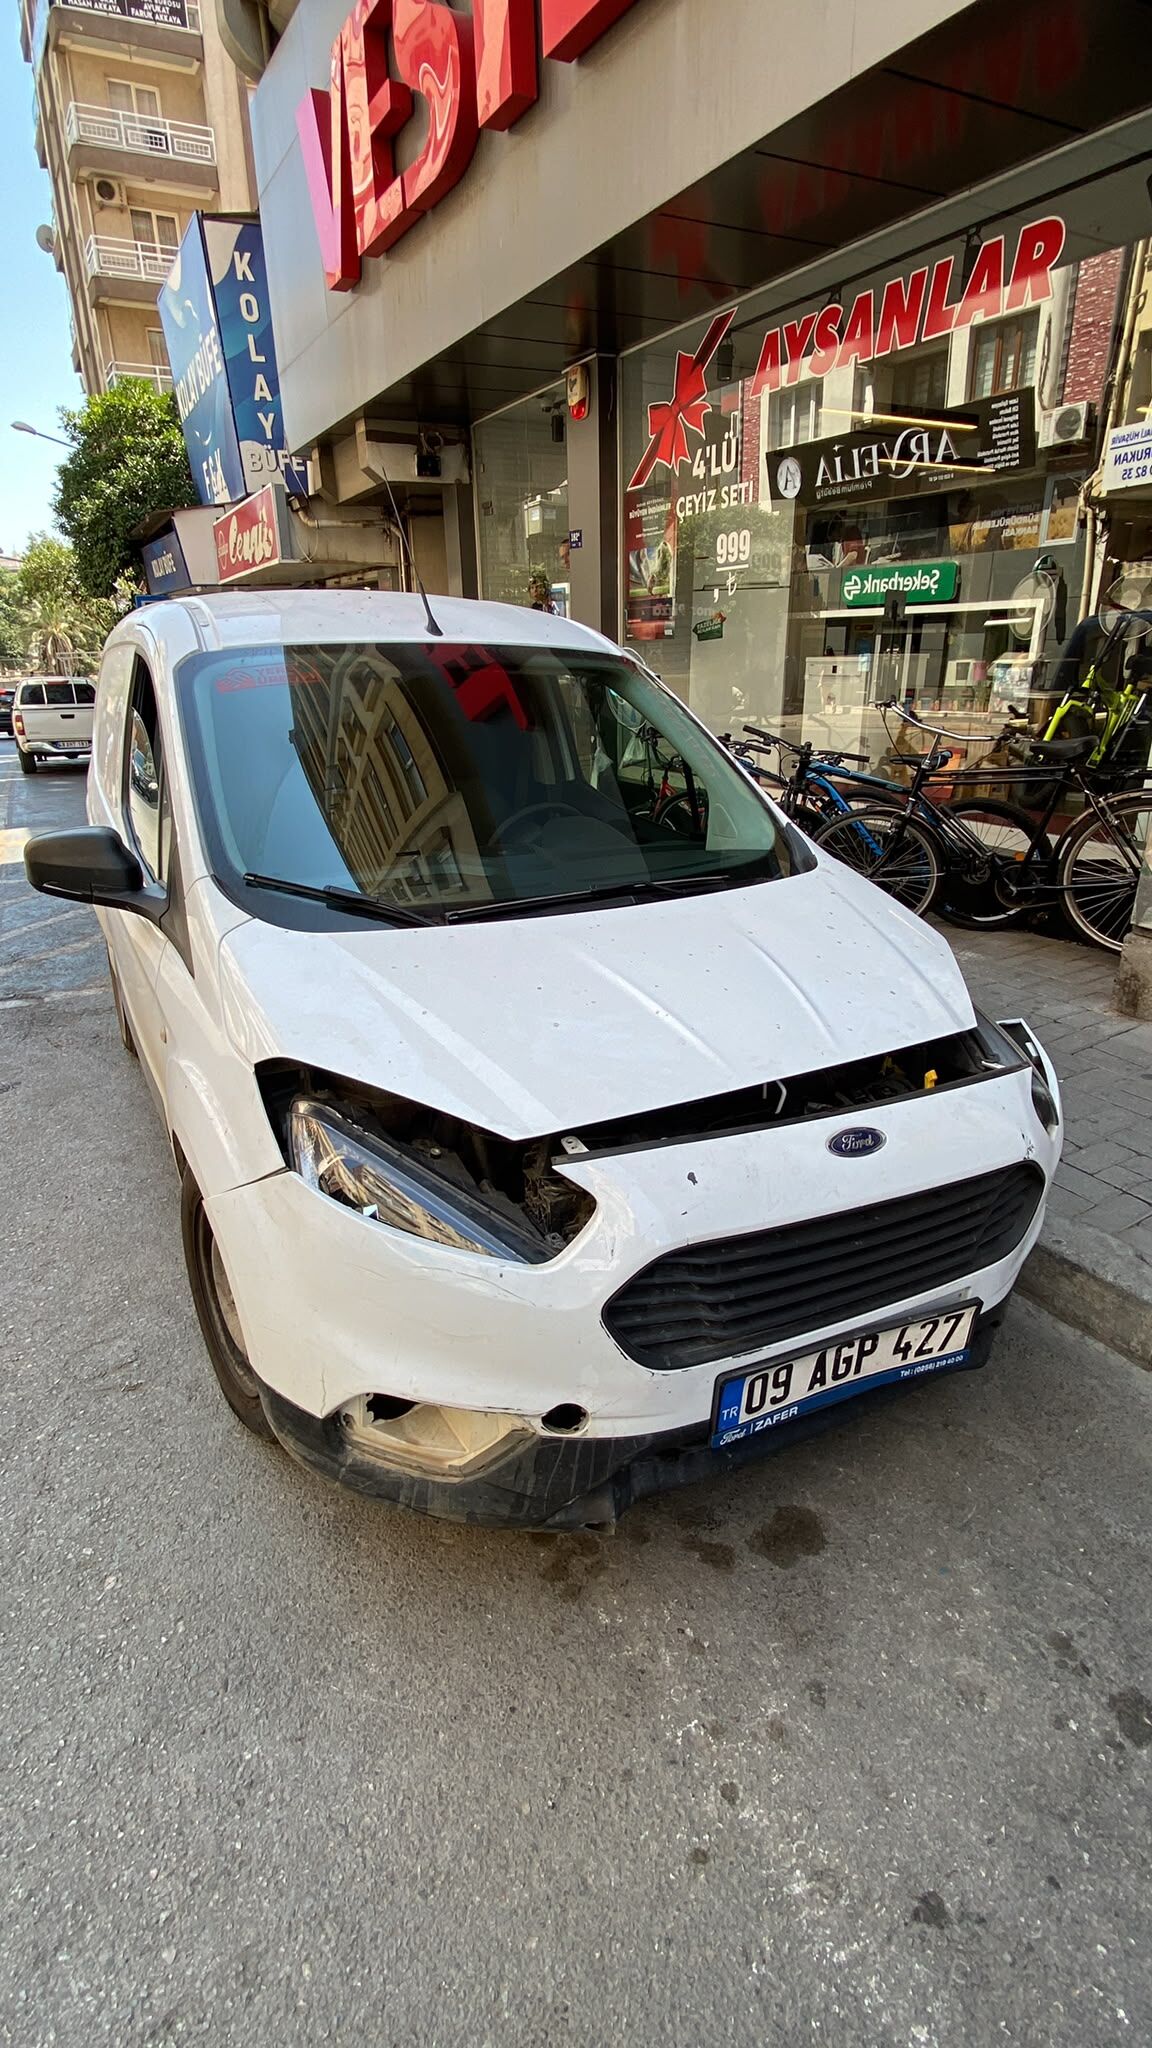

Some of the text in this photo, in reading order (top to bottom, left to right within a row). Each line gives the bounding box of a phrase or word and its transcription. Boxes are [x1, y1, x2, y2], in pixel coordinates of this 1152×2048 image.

[143, 3, 170, 15] AVUKAT
[749, 215, 1067, 399] AYSANLAR
[250, 443, 306, 475] BÜFE
[692, 431, 737, 480] 4'LÜ
[676, 474, 754, 522] ÇEYİZ SETİ
[716, 528, 751, 565] 999
[841, 1133, 875, 1151] Ford
[744, 1313, 966, 1415] 09 AGP 427
[719, 1406, 799, 1446] Ford ZAFER
[722, 1405, 739, 1421] TR
